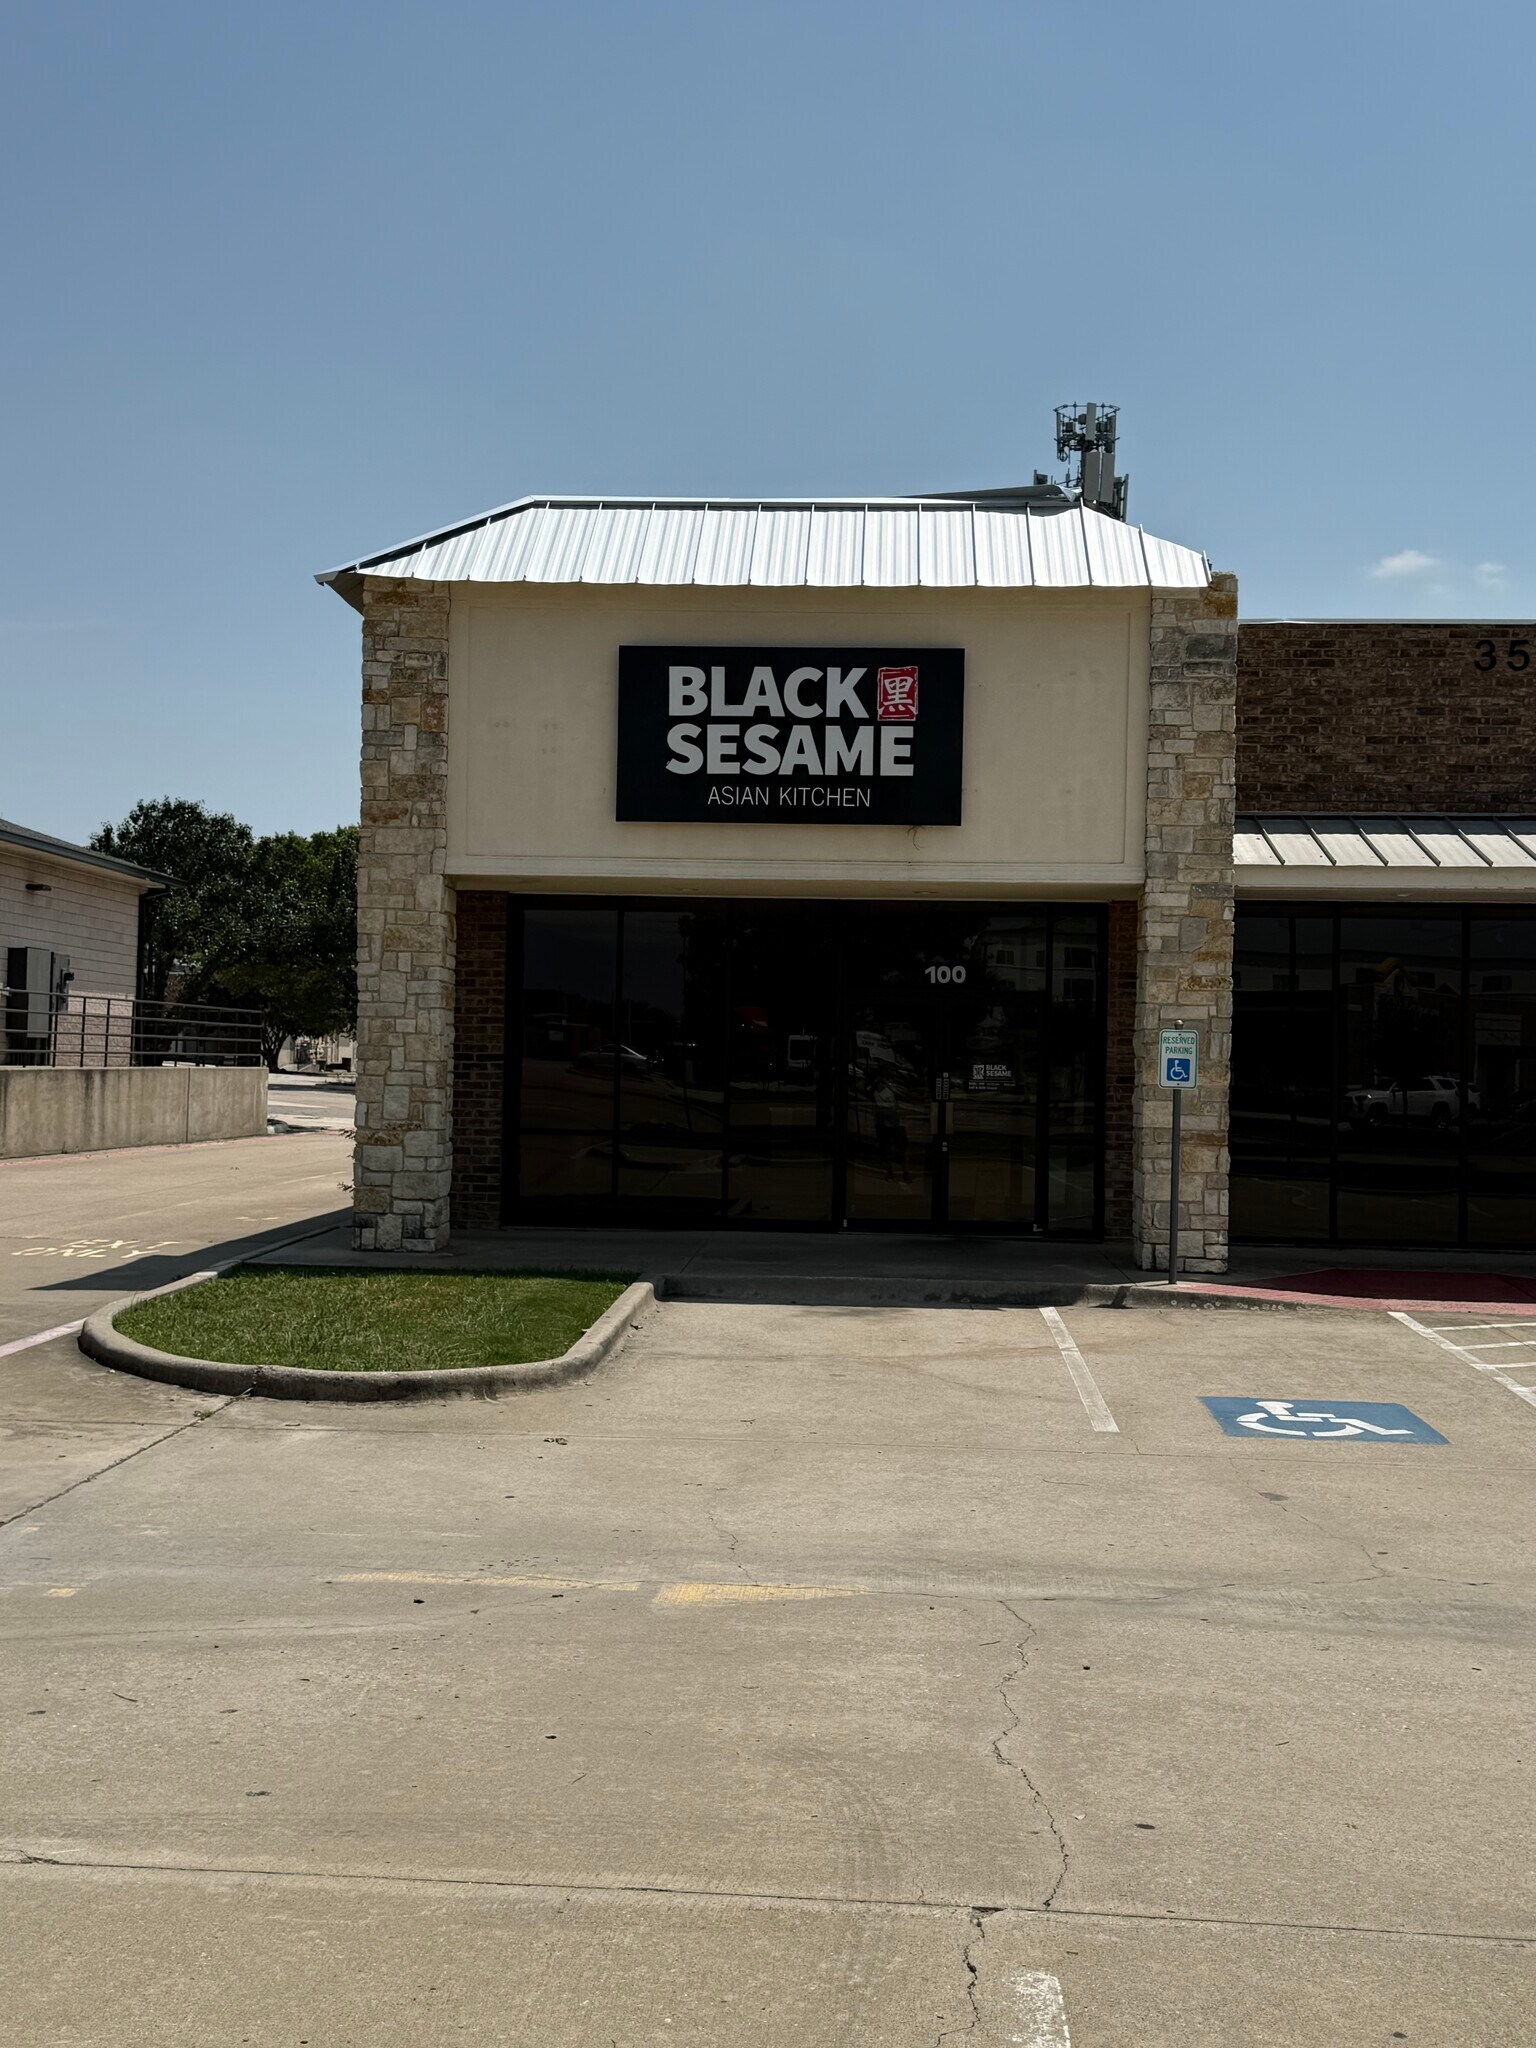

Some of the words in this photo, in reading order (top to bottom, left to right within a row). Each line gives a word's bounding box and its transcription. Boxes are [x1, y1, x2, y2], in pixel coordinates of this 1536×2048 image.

[1473, 639, 1531, 672] 35
[668, 666, 870, 718] BLACK
[665, 723, 914, 776] SESAME
[707, 786, 770, 806] ASIAN
[779, 787, 871, 808] KITCHEN
[924, 965, 967, 984] 100
[1163, 1036, 1195, 1044] RESERVED
[1165, 1046, 1193, 1055] PARKING
[11, 1247, 160, 1258] ONLY
